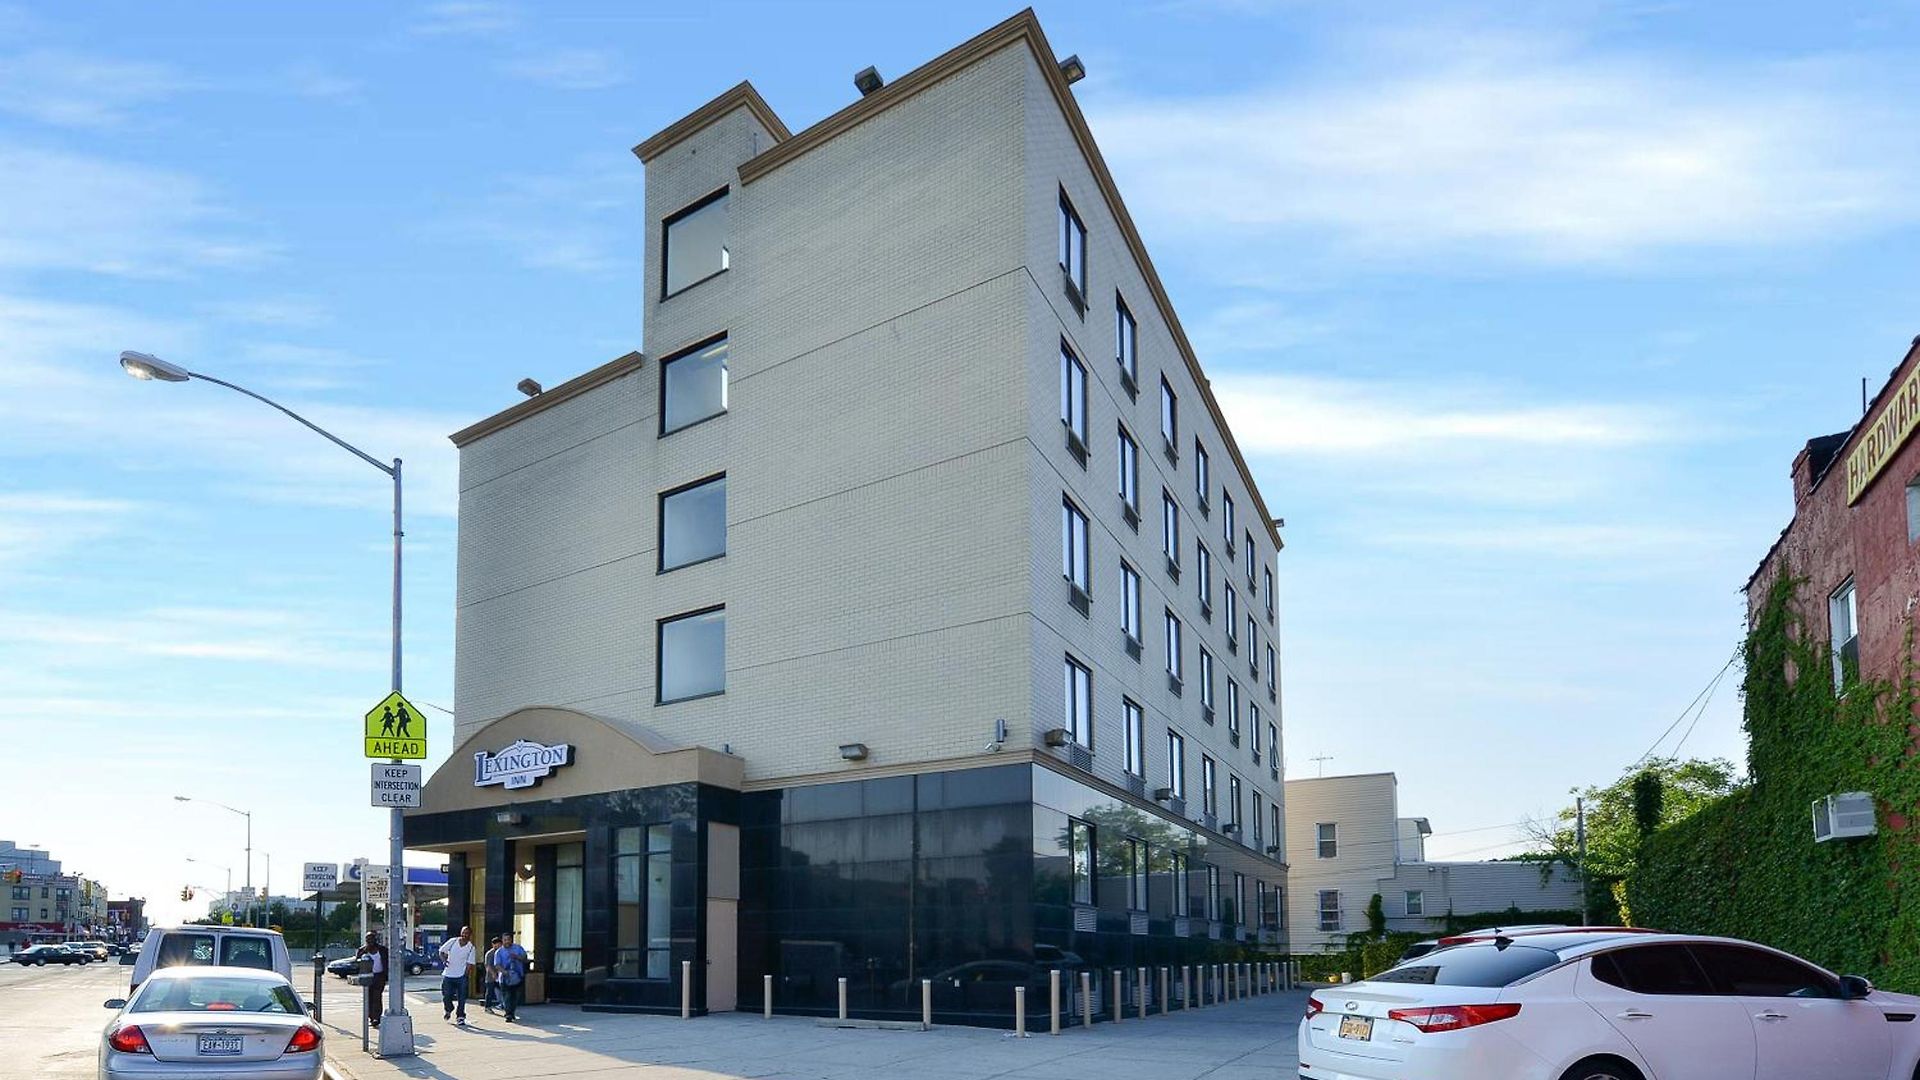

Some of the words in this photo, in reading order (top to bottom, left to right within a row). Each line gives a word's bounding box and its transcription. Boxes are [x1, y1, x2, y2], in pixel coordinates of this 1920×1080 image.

[1850, 369, 1920, 494] HARDWAR
[373, 741, 419, 755] AHEAD
[475, 748, 563, 783] LEXINGTON
[384, 768, 408, 778] KEEP
[374, 780, 420, 791] INTERSECTION
[511, 775, 527, 785] INN
[381, 793, 412, 803] CLEAR
